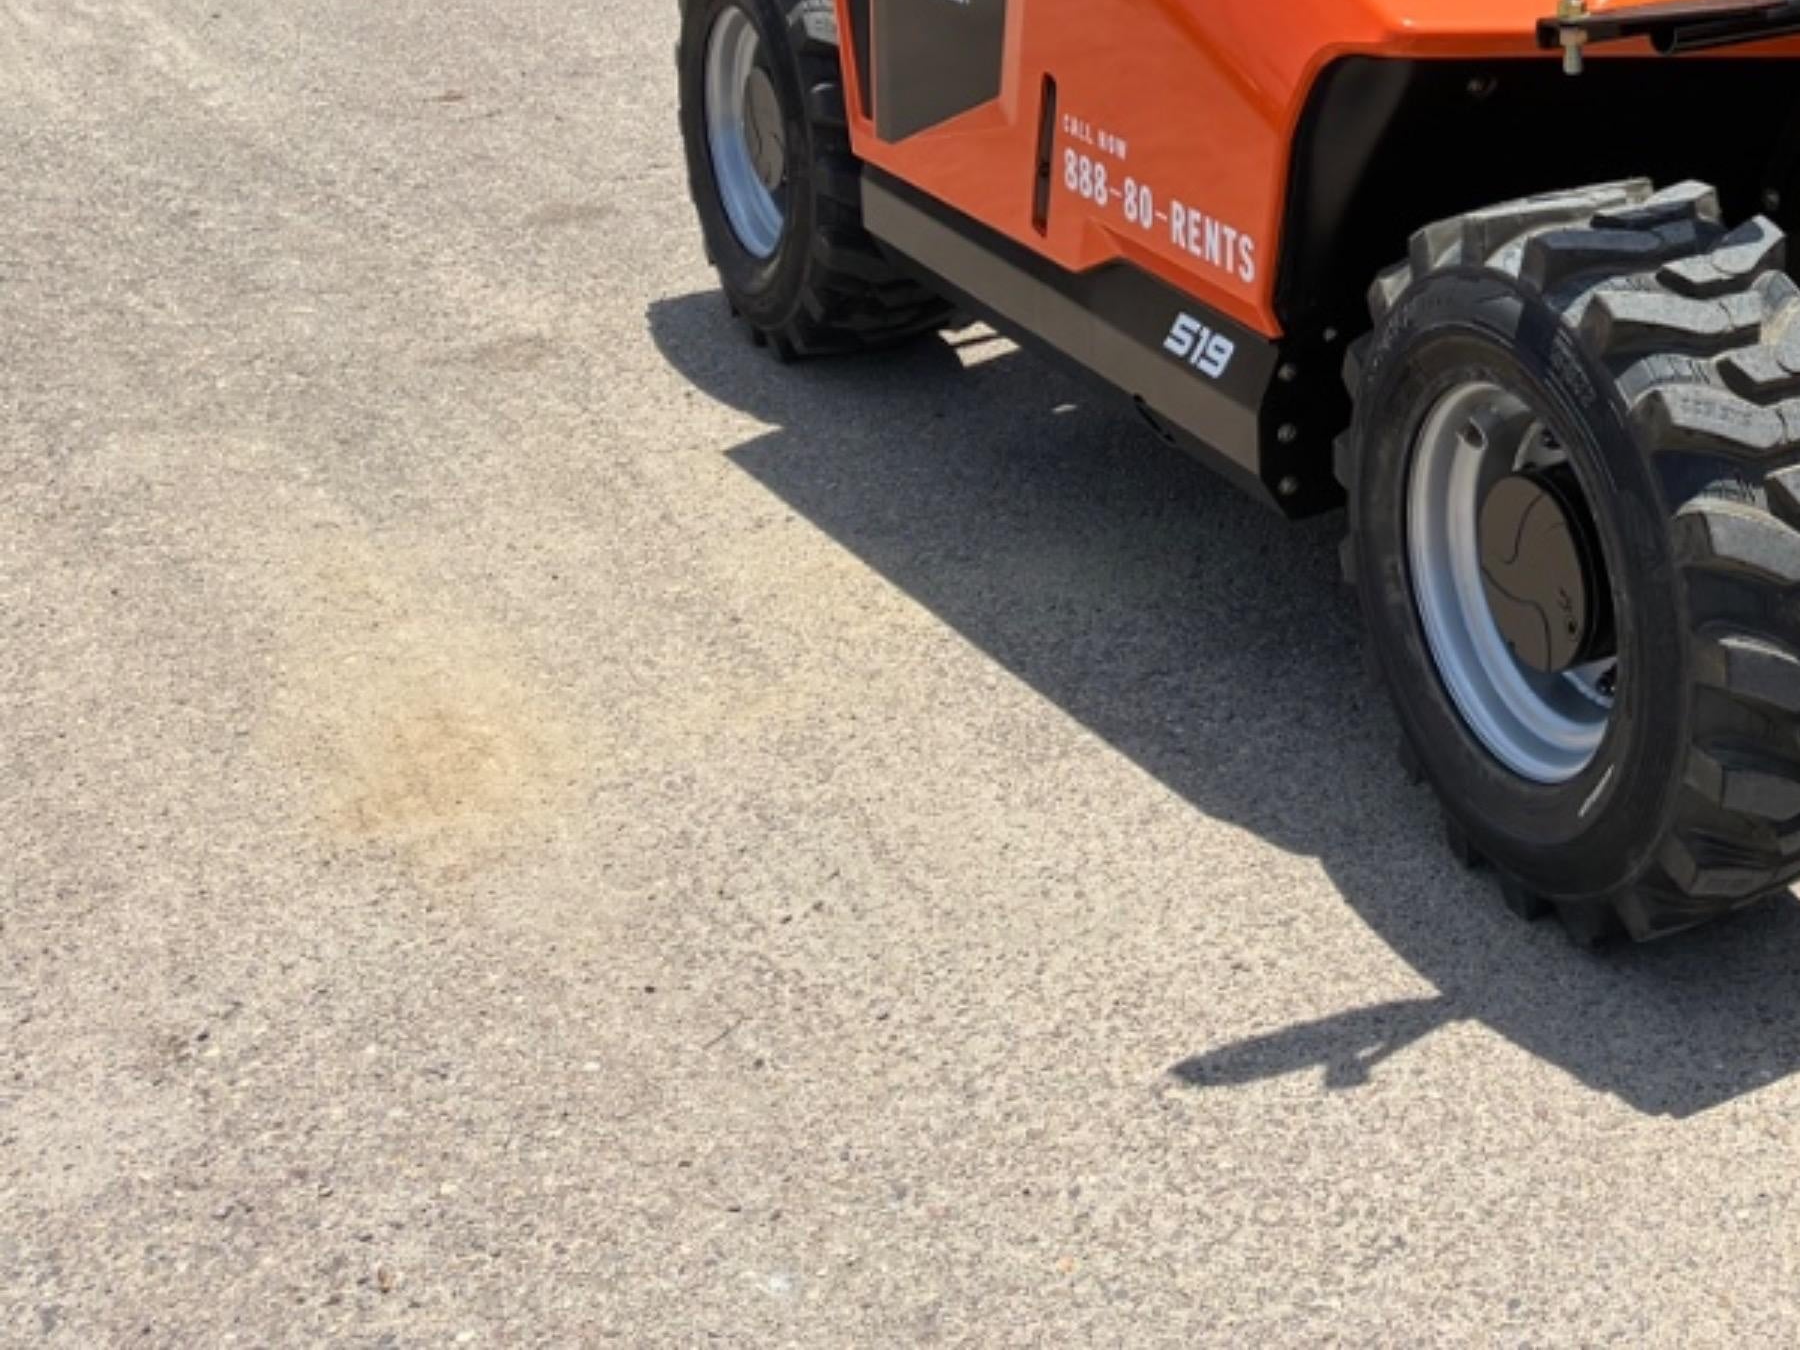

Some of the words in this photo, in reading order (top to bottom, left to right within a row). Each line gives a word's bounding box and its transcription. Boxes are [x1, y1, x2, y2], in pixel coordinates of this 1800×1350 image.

[1063, 113, 1093, 145] CALL
[1097, 128, 1128, 161] NOW
[1063, 147, 1255, 283] 888-80-RENTS
[1162, 310, 1235, 379] S19
